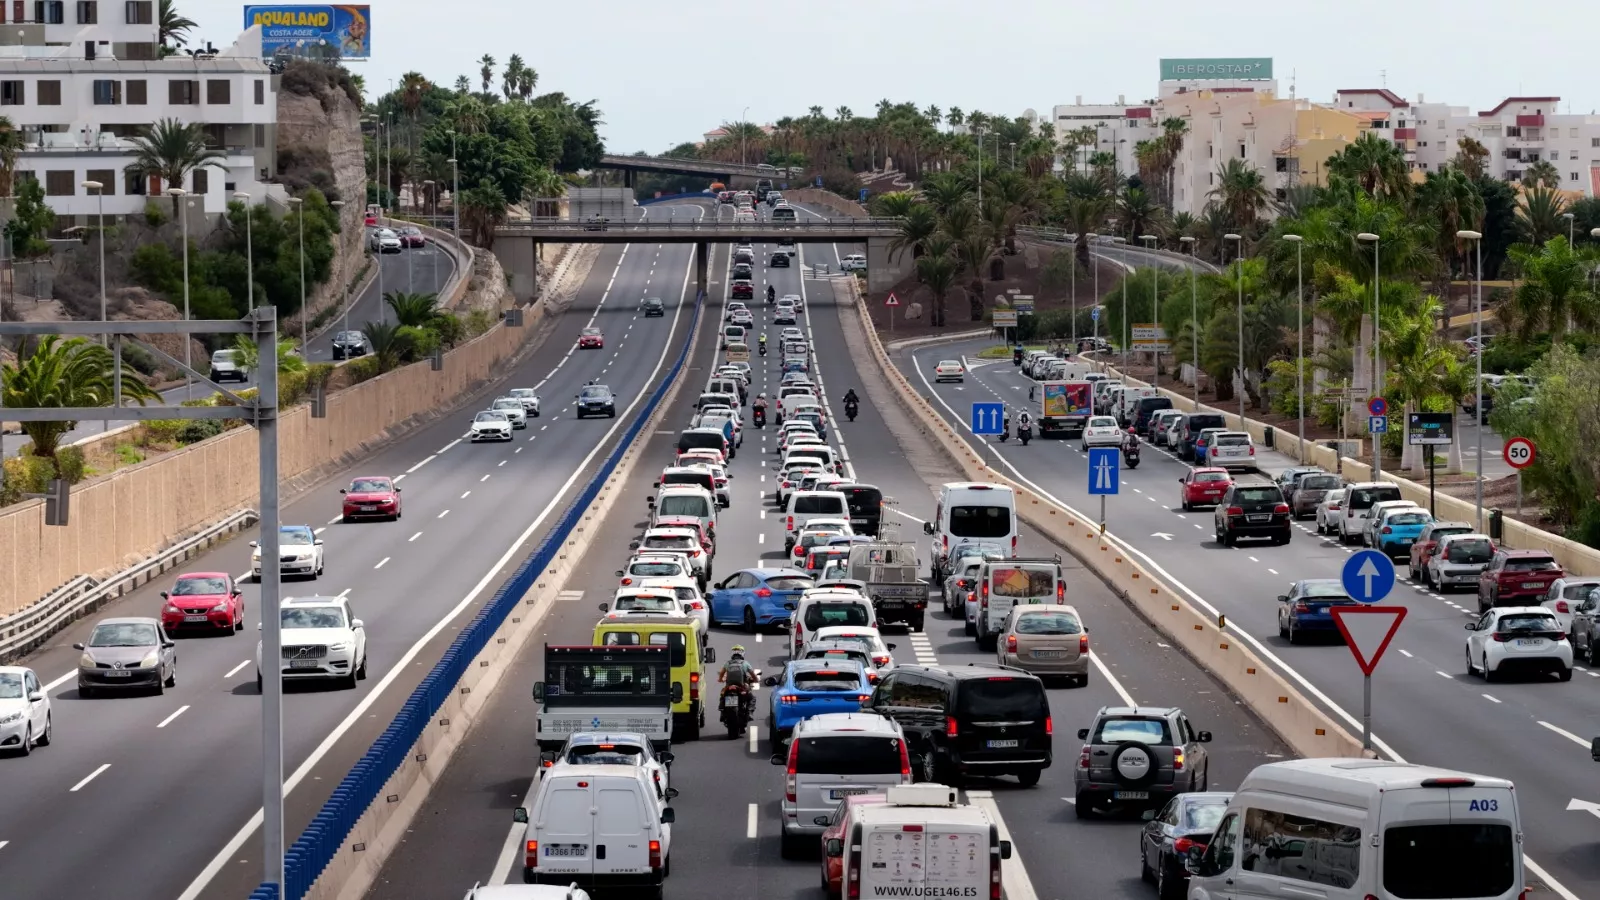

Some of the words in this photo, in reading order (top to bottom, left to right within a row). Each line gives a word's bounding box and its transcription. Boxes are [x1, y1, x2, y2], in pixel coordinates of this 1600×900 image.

[253, 11, 329, 27] AQUALAND
[269, 29, 291, 37] COSTA
[293, 29, 313, 37] ADEJE
[1172, 64, 1252, 74] IBEROSTAR
[1371, 417, 1384, 432] P
[1411, 415, 1418, 423] P
[1510, 447, 1528, 458] 50
[1469, 799, 1498, 811] A03
[550, 848, 569, 856] 3366
[570, 848, 585, 856] FDD
[874, 886, 977, 897] WWW.UGE146.ES
